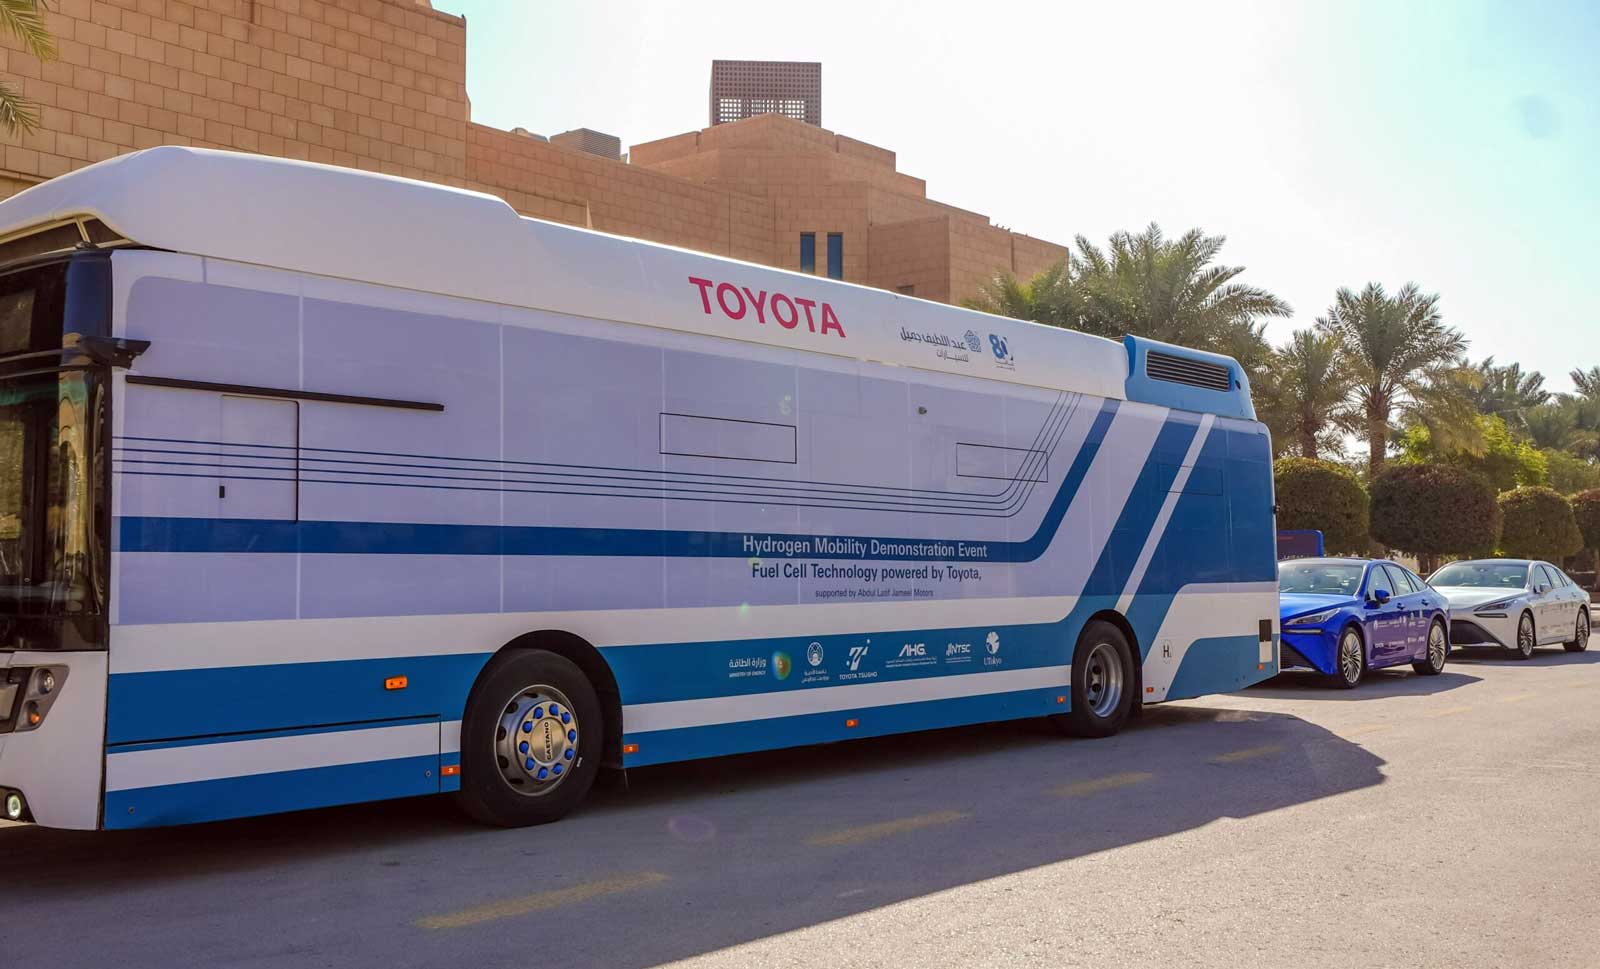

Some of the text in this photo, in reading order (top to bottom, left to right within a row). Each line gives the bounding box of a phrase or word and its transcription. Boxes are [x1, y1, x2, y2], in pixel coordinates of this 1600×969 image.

[688, 276, 847, 338] TOYOTA
[900, 327, 967, 351] عبد اللطيف جميل
[743, 535, 988, 559] Hydrogen Mobility Demonstration Event
[752, 562, 982, 582] Fuel Cell Technology powered by Toyota,
[815, 589, 847, 599] supported
[848, 588, 857, 598] by
[898, 643, 926, 658] AHG
[728, 657, 767, 669] وزارة الطاقة
[544, 722, 552, 760] CAETANO
